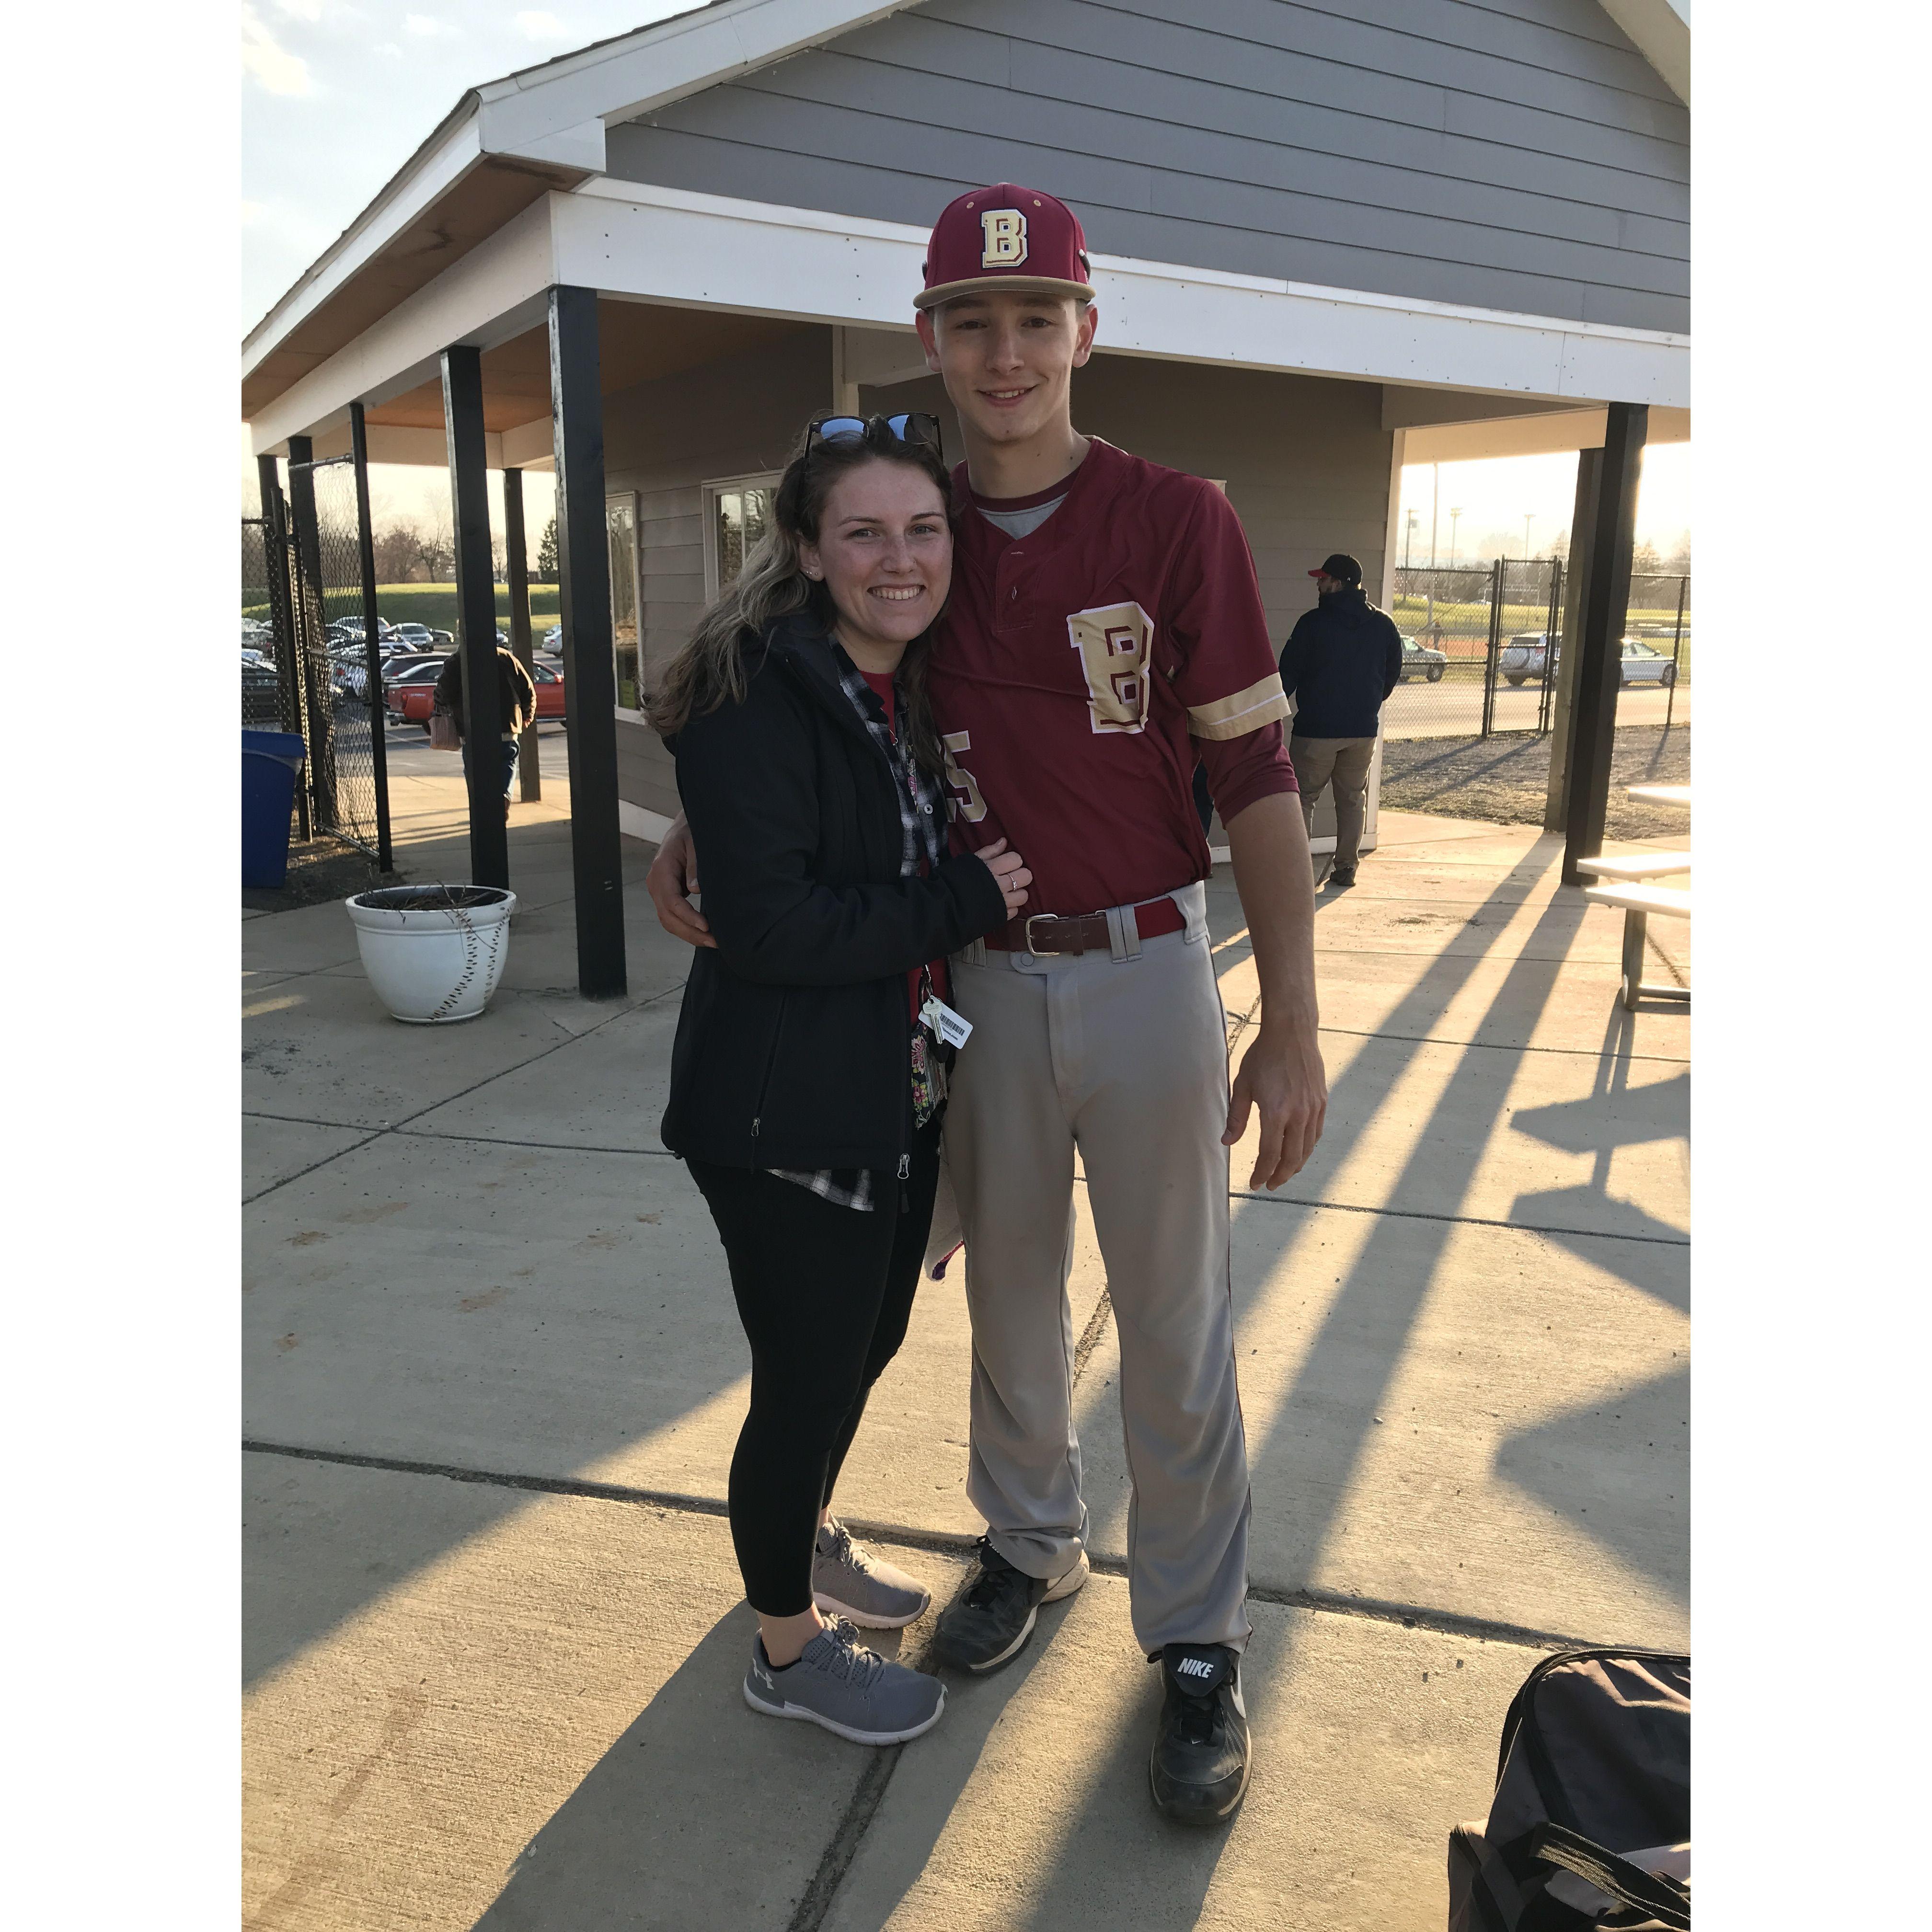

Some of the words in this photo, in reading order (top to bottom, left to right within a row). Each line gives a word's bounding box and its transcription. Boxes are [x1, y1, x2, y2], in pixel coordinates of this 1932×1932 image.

[981, 208, 1028, 269] B
[1066, 601, 1154, 734] B
[936, 730, 988, 823] 5
[1177, 1658, 1214, 1679] NIKE
